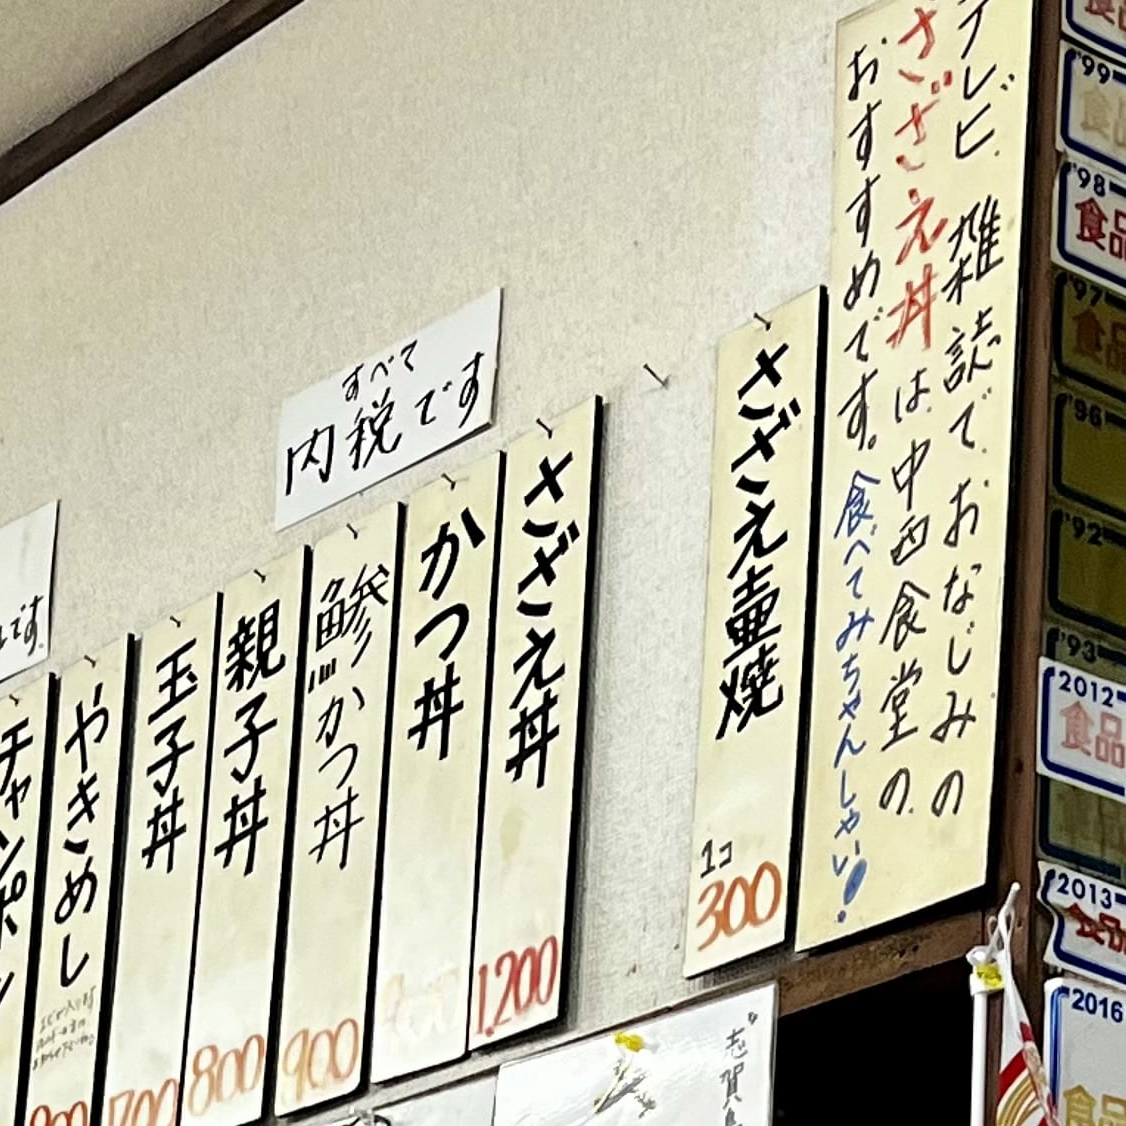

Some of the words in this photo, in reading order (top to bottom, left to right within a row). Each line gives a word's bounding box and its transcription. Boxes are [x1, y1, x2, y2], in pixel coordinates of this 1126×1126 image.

[342, 339, 418, 401] すべて
[285, 352, 485, 496] 内税です
[407, 506, 486, 760] かつ丼
[505, 451, 581, 789] さざえ丼
[1058, 670, 1115, 708] 2012
[141, 637, 199, 874] 玉子丼
[214, 598, 286, 877] 親子丼
[54, 682, 109, 988] やきめし
[698, 860, 782, 950] 300
[1057, 872, 1113, 910] 2013
[1071, 987, 1124, 1024] 2016
[188, 1033, 265, 1117] 800
[282, 1017, 359, 1103] 900
